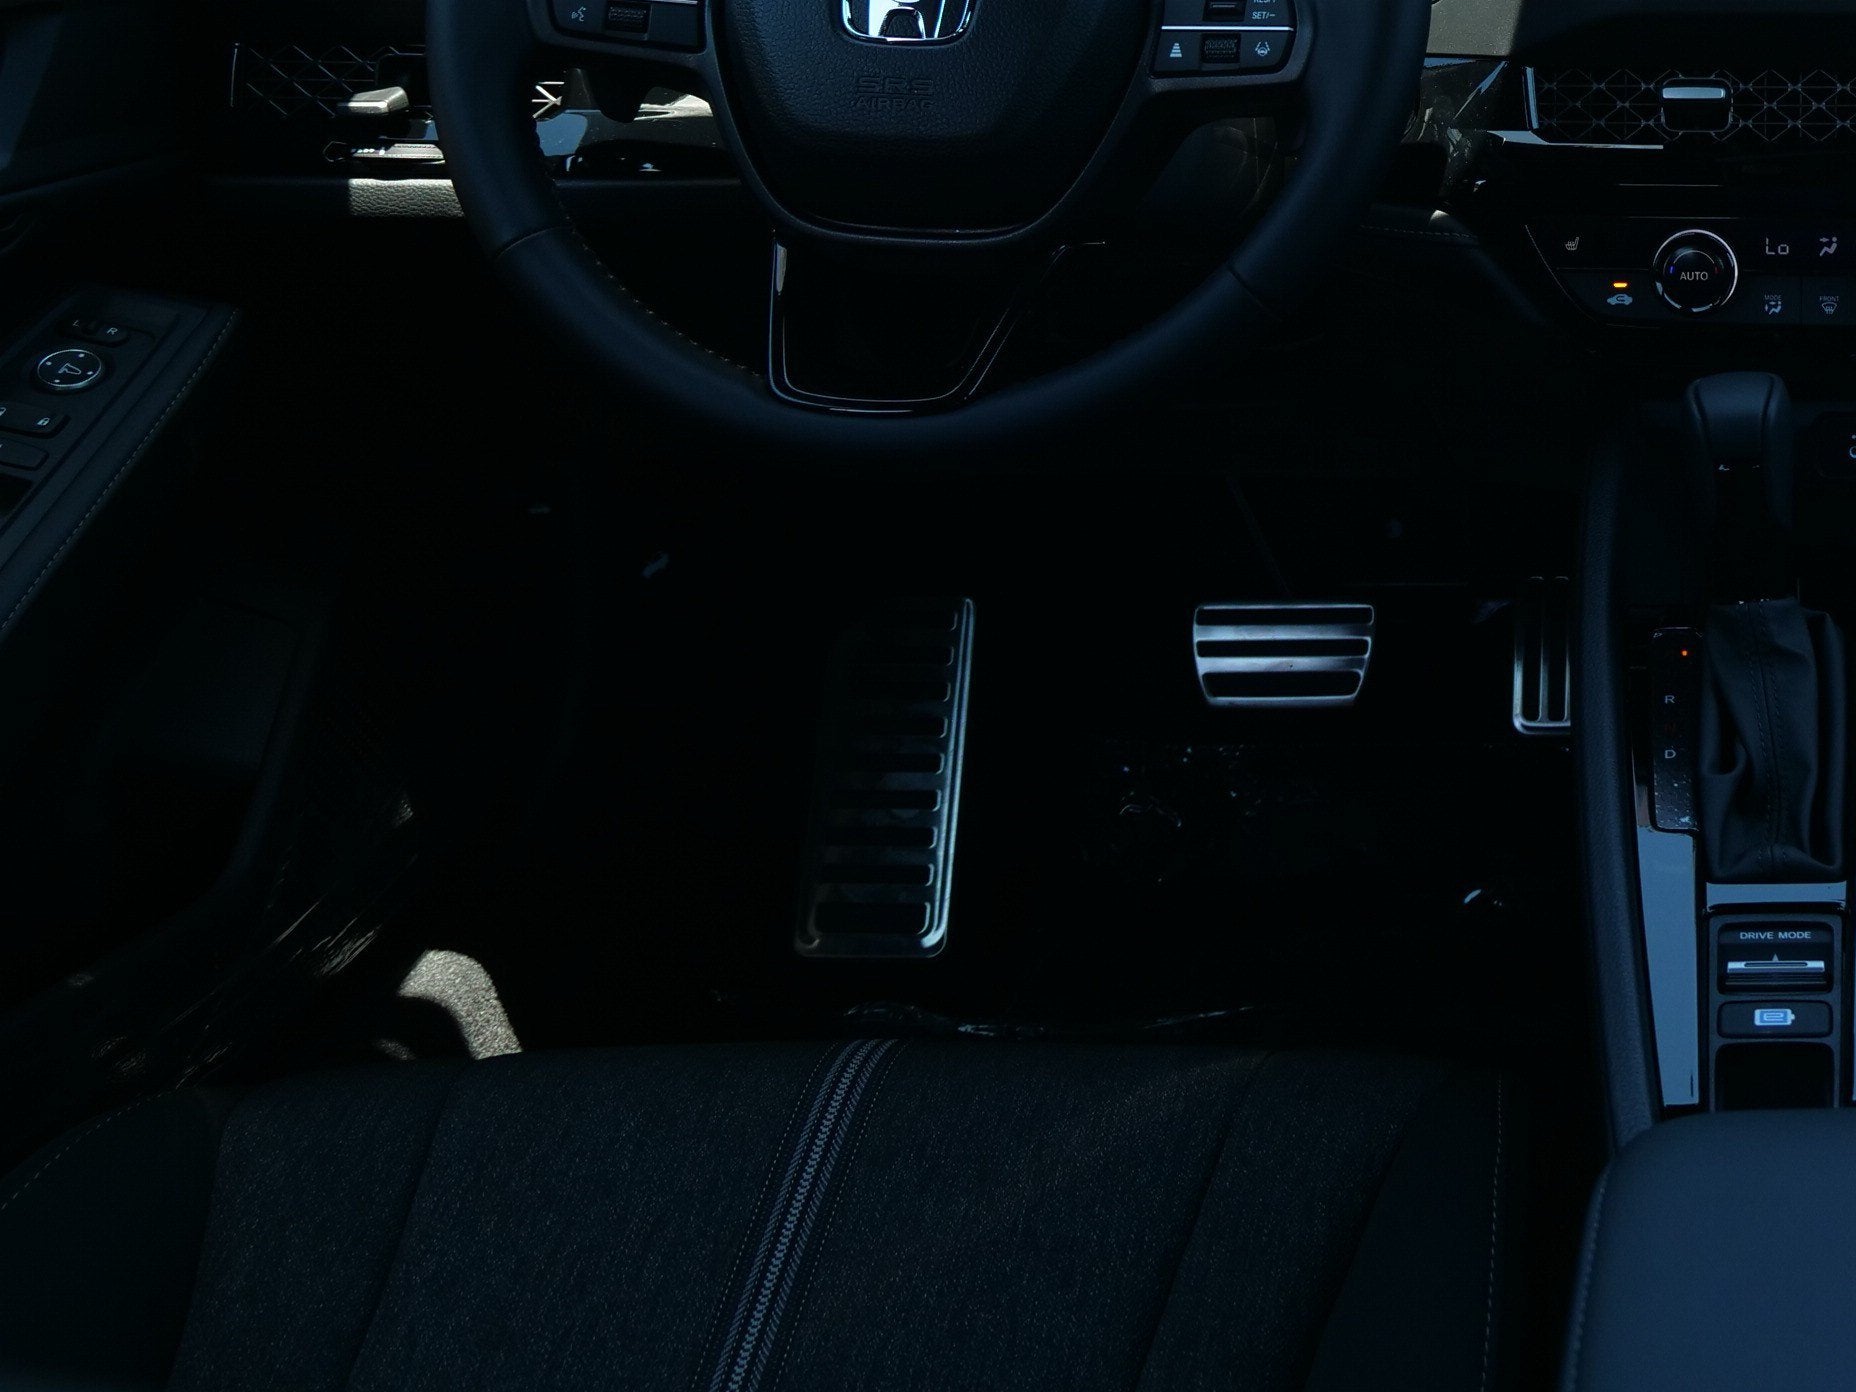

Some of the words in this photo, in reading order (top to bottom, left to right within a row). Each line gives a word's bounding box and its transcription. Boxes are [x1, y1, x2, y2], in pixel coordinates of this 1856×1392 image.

[1679, 271, 1709, 282] AUTO
[1764, 294, 1782, 302] MODE
[1819, 295, 1840, 303] FRONT
[106, 327, 118, 336] R
[1665, 695, 1675, 704] R
[1664, 749, 1677, 759] D
[1739, 931, 1774, 939] DRIVE
[1778, 931, 1811, 939] MODE
